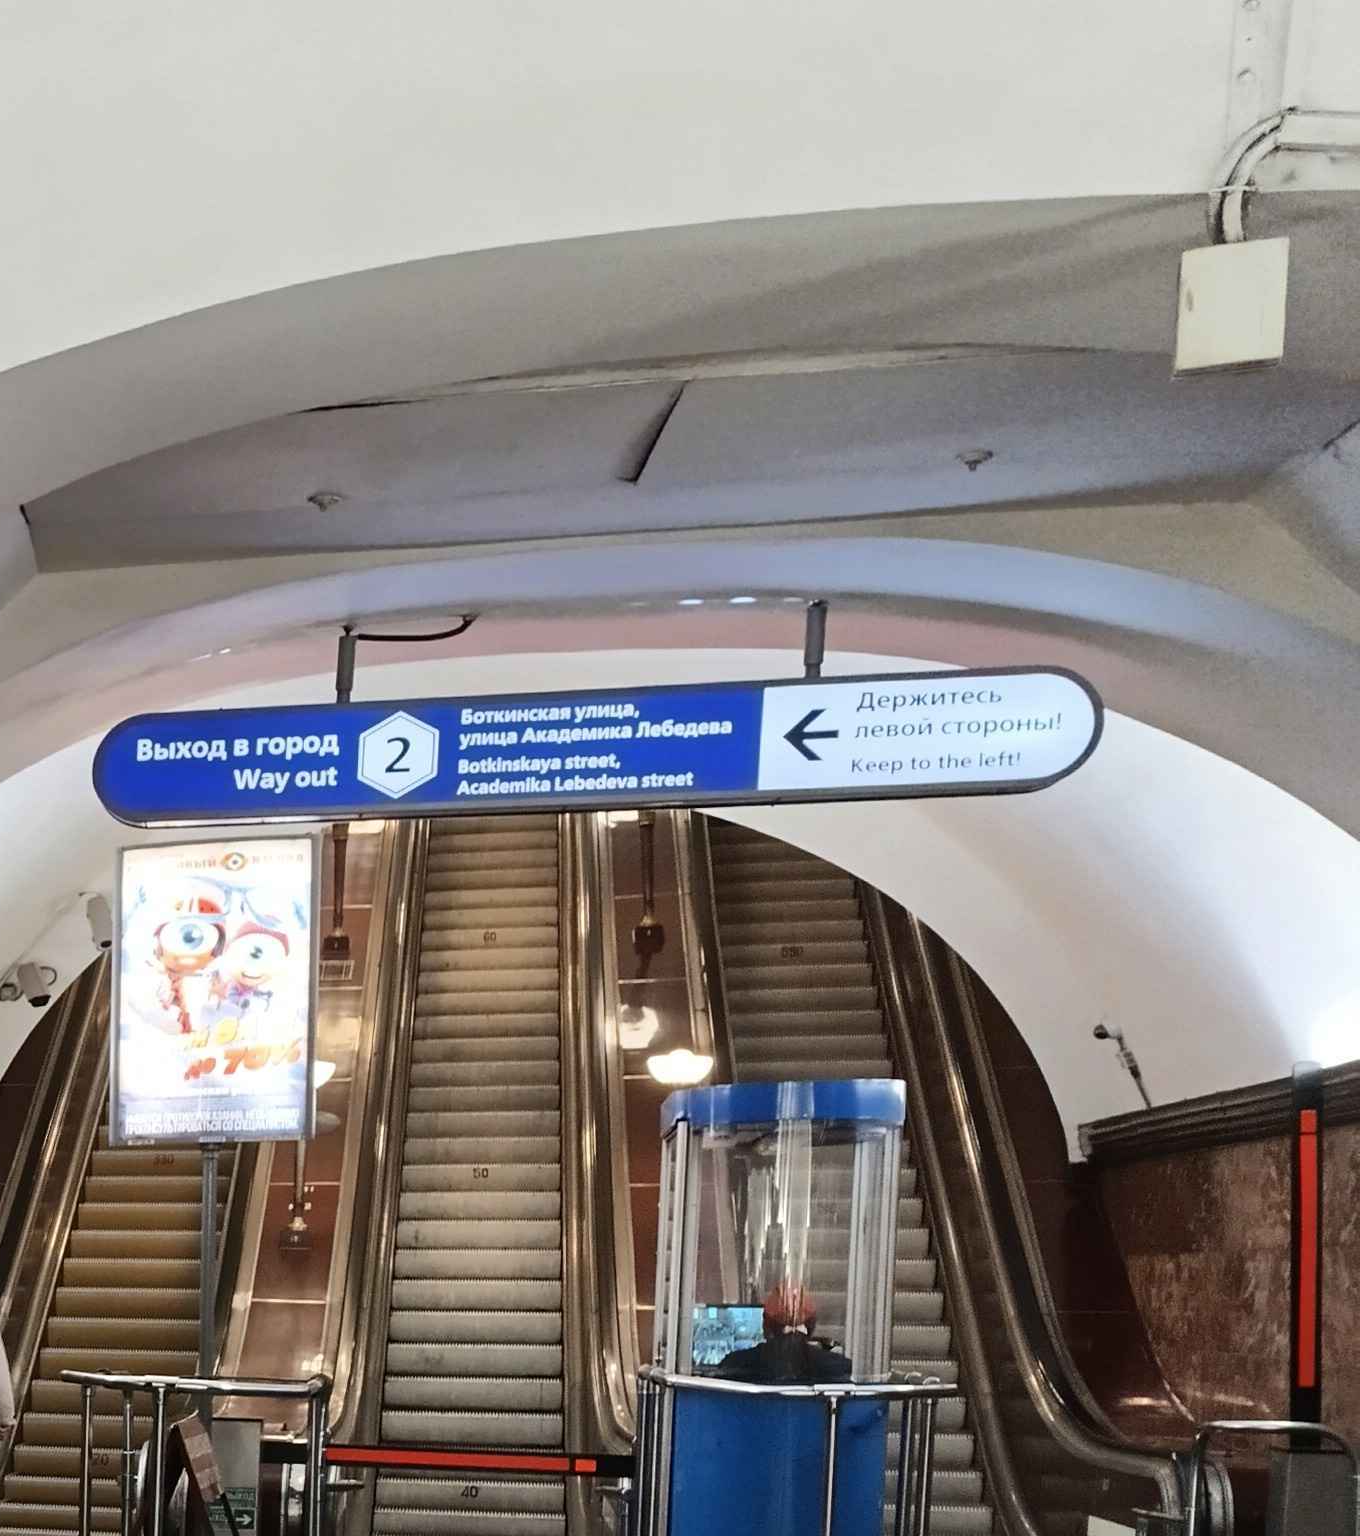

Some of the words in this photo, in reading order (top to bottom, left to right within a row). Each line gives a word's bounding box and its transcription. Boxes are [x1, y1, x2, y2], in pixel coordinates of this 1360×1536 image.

[856, 689, 1002, 712] Держитесь
[460, 707, 571, 725] Боткинская
[574, 703, 640, 723] улица,
[855, 718, 933, 738] левой
[941, 712, 1062, 737] стороны!
[459, 730, 518, 749] улица
[521, 723, 632, 744] Академика
[636, 719, 733, 738] Лебедева
[136, 738, 227, 761] Выход
[233, 737, 249, 756] в
[256, 734, 340, 760] город
[384, 736, 411, 773] 2
[458, 756, 562, 776] Botkinskaya
[565, 753, 621, 770] street,
[851, 757, 904, 774] Keep
[910, 757, 931, 770] to
[938, 754, 972, 769] the
[979, 751, 1021, 768] left!
[233, 768, 290, 793] Way
[295, 766, 339, 788] out
[456, 776, 551, 796] Academika
[554, 773, 638, 792] Lebedeva
[641, 771, 694, 788] street
[460, 1484, 479, 1498] 40
